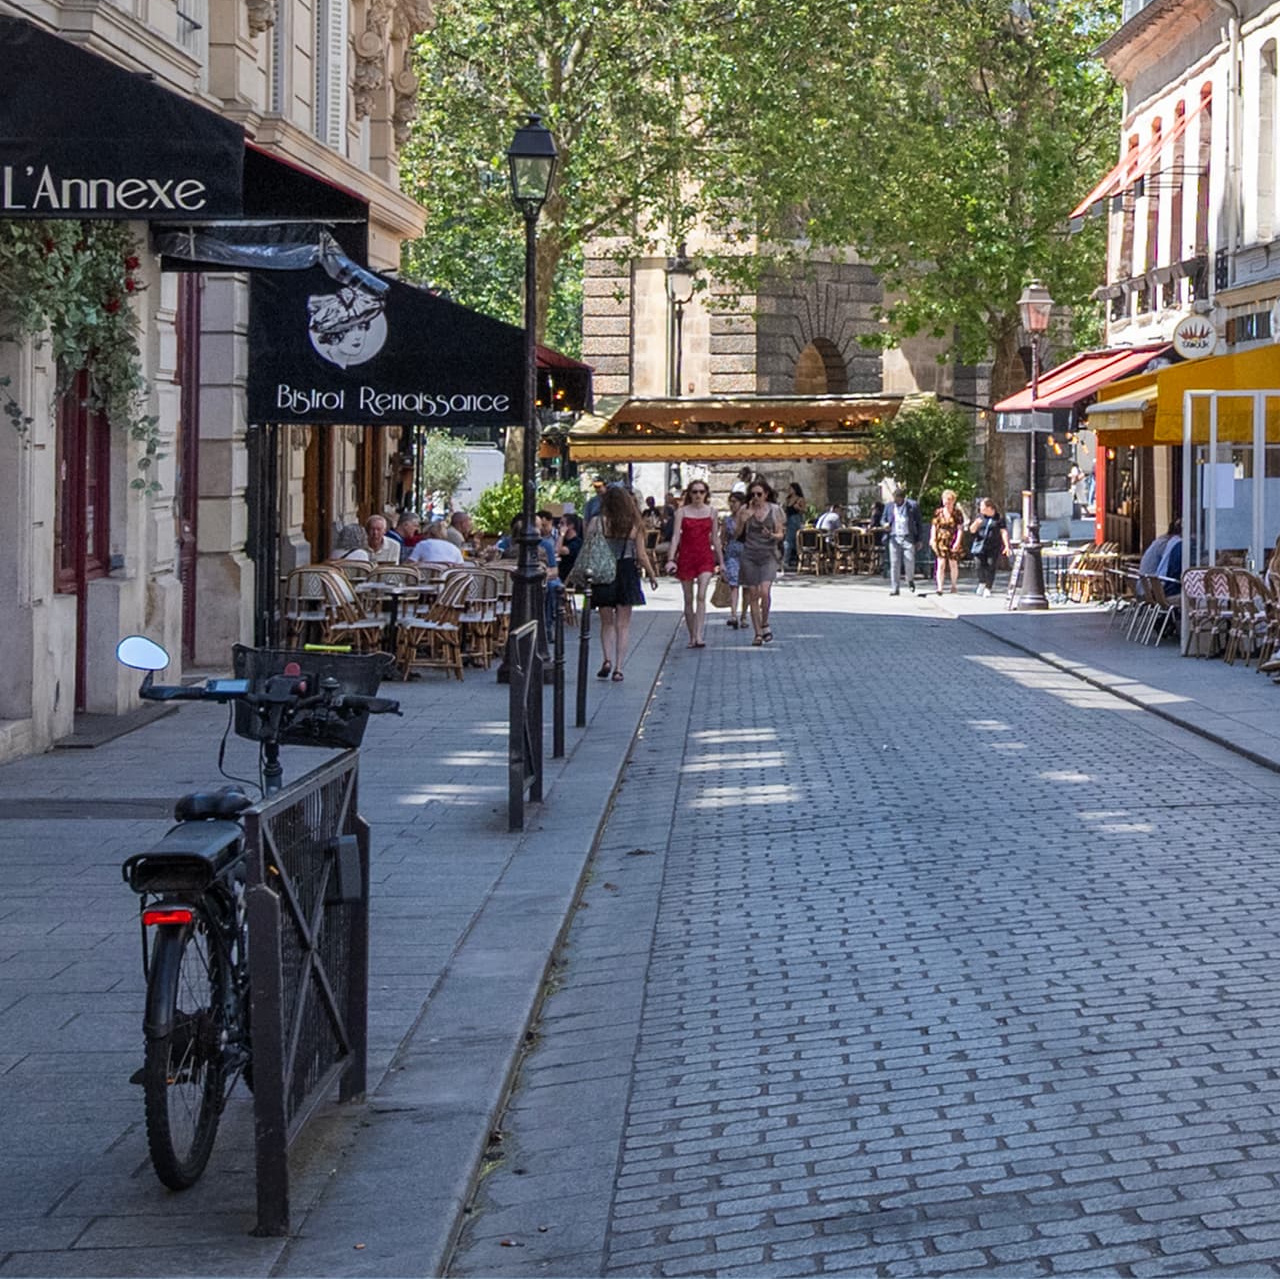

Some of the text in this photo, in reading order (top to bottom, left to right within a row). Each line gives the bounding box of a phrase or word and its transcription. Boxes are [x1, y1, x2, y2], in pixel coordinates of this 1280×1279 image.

[4, 164, 206, 210] L'Annexe
[277, 383, 510, 417] Bistrot Renaissance
